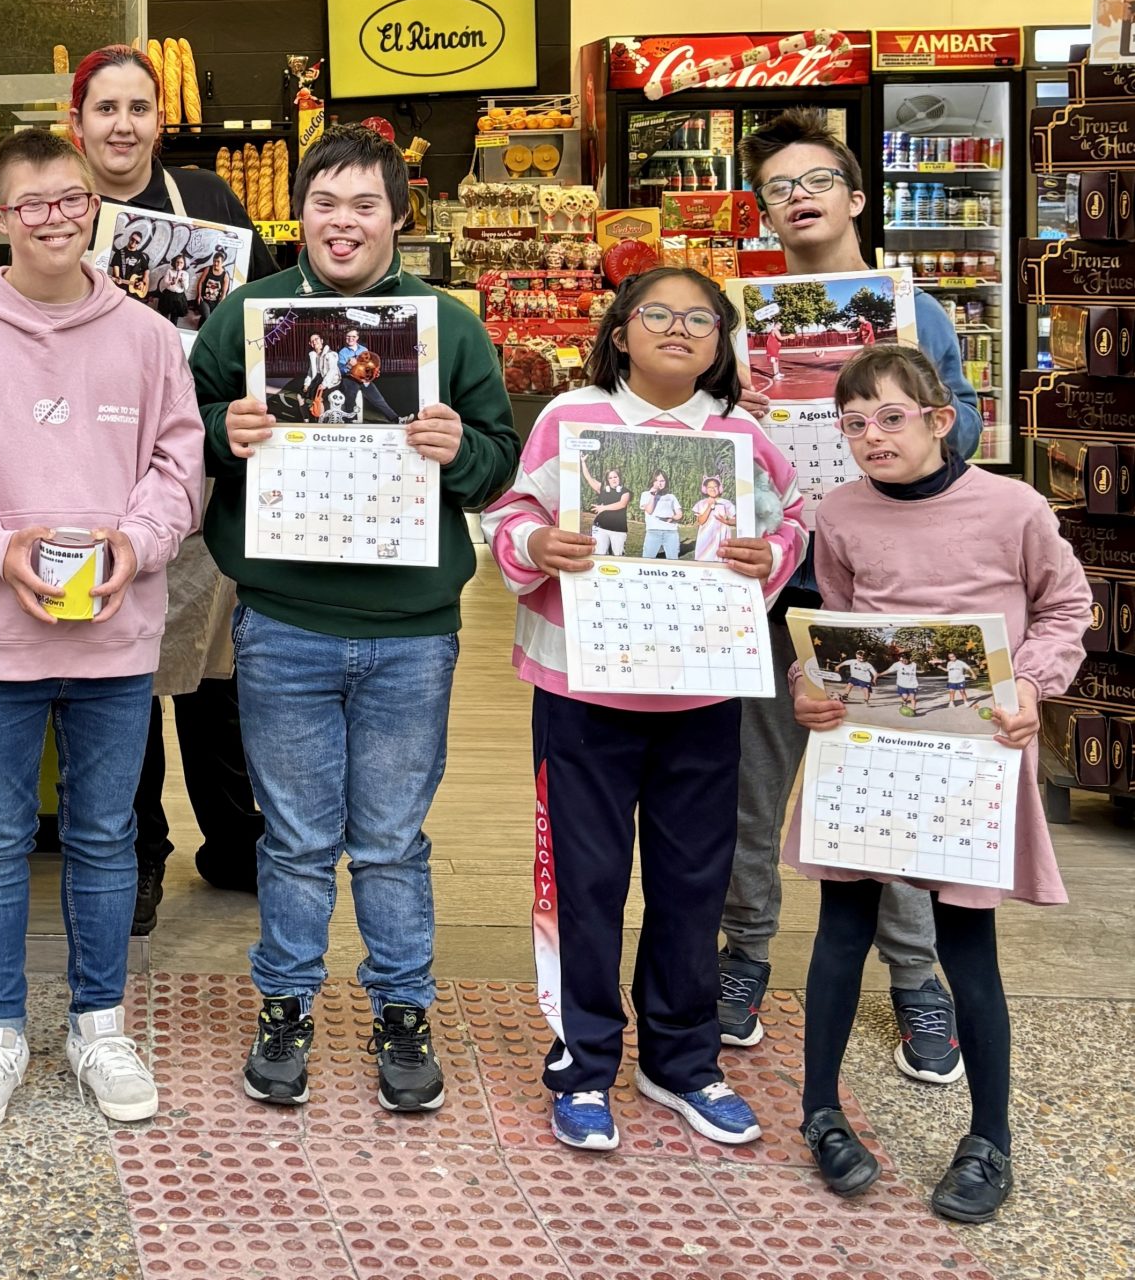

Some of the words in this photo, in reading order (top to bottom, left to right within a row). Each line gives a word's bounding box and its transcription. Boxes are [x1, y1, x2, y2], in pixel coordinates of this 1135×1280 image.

[377, 22, 403, 52] El
[406, 20, 487, 51] Rincón
[914, 34, 997, 52] AMBAR
[299, 111, 324, 147] ColaCao
[1070, 115, 1128, 140] Trenza
[1081, 140, 1092, 150] de
[1063, 248, 1122, 273] Trenza
[1073, 274, 1085, 284] de
[1056, 382, 1116, 407] Trenza
[1067, 408, 1078, 418] de
[313, 433, 356, 443] Octubre
[360, 434, 373, 443] 26
[414, 518, 425, 526] 25
[46, 548, 83, 559] SOLIDARIAS
[638, 568, 668, 577] Junio
[671, 570, 686, 578] 26
[877, 736, 934, 750] Noviembre
[937, 742, 951, 750] 26
[828, 822, 839, 830] 23
[854, 825, 864, 833] 24
[879, 828, 890, 836] 25
[905, 831, 917, 839] 26
[959, 838, 970, 846] 28
[986, 841, 998, 849] 29
[536, 800, 551, 911] MONCAYO
